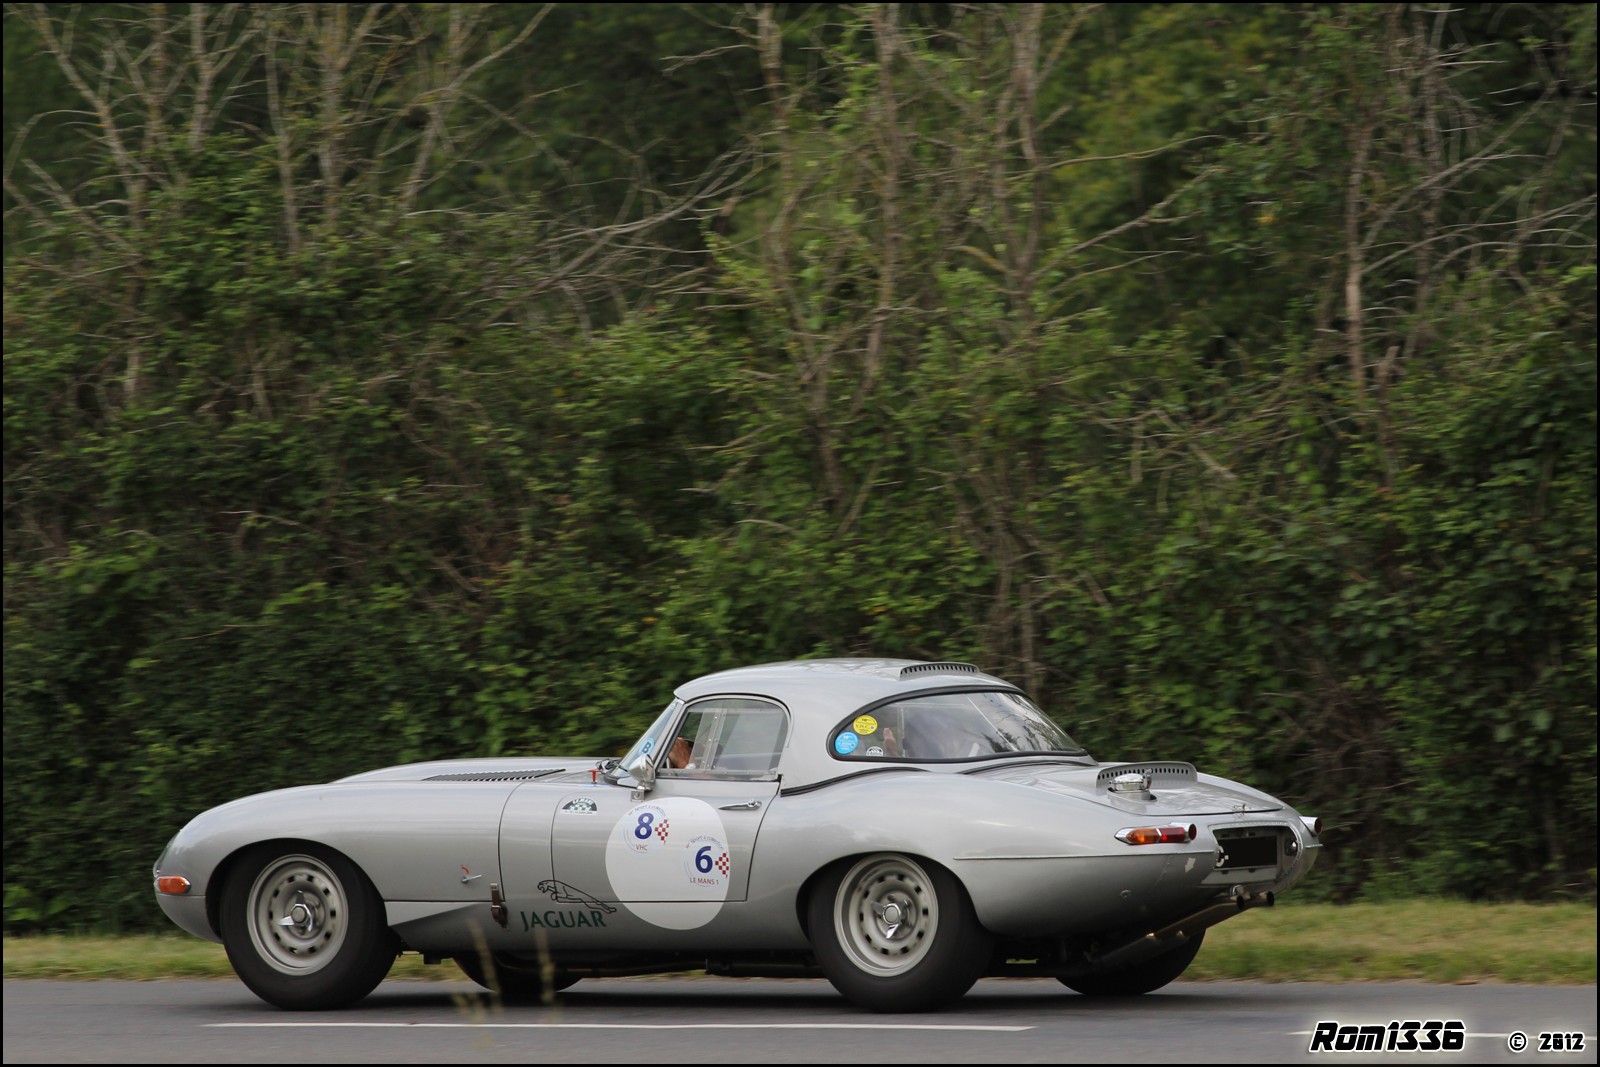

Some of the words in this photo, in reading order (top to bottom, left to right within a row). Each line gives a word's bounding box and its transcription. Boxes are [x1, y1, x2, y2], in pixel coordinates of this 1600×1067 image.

[642, 741, 652, 754] B
[634, 812, 654, 840] 8
[695, 845, 713, 874] 6
[520, 910, 607, 932] JAGUAR
